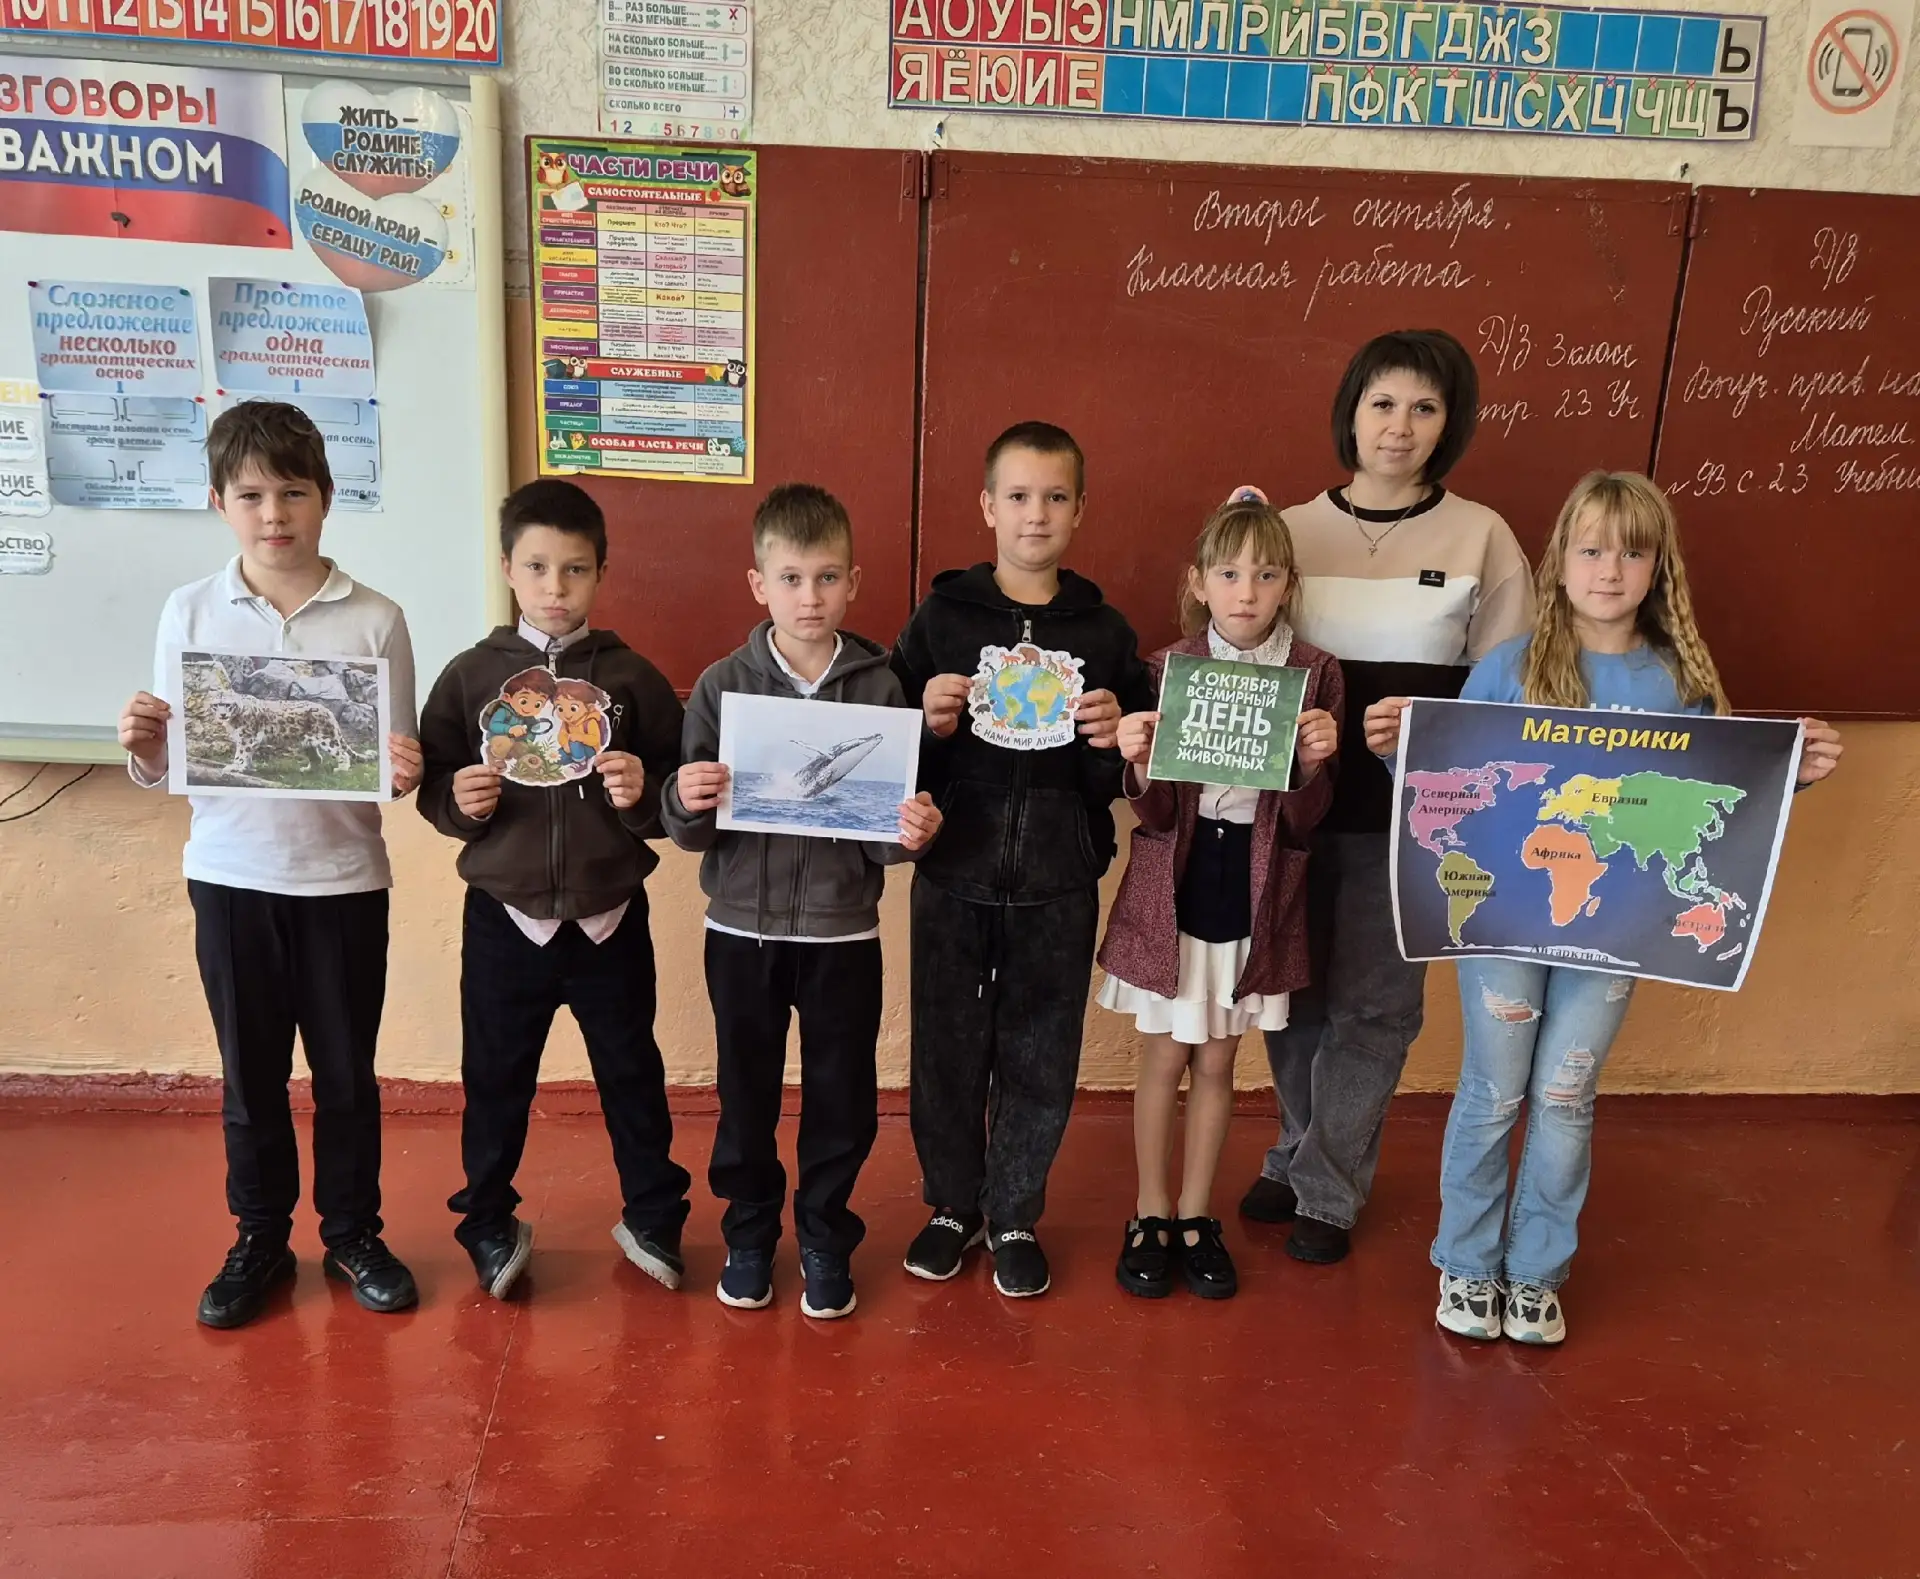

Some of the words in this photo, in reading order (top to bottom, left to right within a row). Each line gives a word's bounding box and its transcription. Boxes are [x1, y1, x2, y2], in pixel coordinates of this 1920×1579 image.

[625, 2, 643, 12] РАЗ
[284, 0, 320, 41] 16
[323, 0, 366, 44] 17
[367, 0, 409, 48] 18
[411, 0, 452, 50] 19
[455, 1, 496, 53] 20
[625, 14, 643, 23] РАЗ
[609, 33, 620, 41] НА
[623, 34, 664, 45] СКОЛЬКО
[609, 45, 621, 53] НА
[623, 46, 664, 57] СКОЛЬКО
[609, 66, 620, 75] ВО
[624, 67, 664, 78] СКОЛЬКО
[609, 78, 620, 86] ВО
[624, 79, 665, 90] СКОЛЬКО
[0, 73, 217, 125] ЗГОВОРЫ
[609, 100, 650, 110] СКОЛЬКО
[653, 103, 681, 113] ВСЕГО
[339, 105, 398, 129] ЖИТЬ
[624, 121, 632, 133] 2
[664, 123, 672, 136] 5
[691, 126, 700, 138] 7
[343, 128, 422, 155] РОДИНЕ
[0, 128, 224, 185] ВАЖНОМ
[333, 153, 433, 180] СЛУЖИТЬ!
[568, 154, 651, 178] ЧАСТИ
[657, 161, 719, 182] РЕЧИ
[587, 187, 702, 201] САМОСТОЯТЕЛЬНЫЕ
[300, 188, 371, 228] РОДНОЙ
[375, 215, 421, 246] КРАЙ
[442, 205, 449, 215] 2
[312, 222, 376, 259] СЕРДЦУ
[379, 247, 420, 275] РАЙ!
[48, 285, 175, 311] Сложное
[233, 282, 347, 311] Простое
[36, 307, 193, 334] предложение
[218, 307, 368, 336] предложение
[1740, 285, 1875, 357] Русский
[59, 335, 177, 355] несколько
[265, 330, 324, 354] одна
[40, 352, 196, 369] грамматических
[219, 350, 370, 369] грамматическая
[96, 367, 145, 380] основ
[268, 365, 325, 379] основа
[610, 366, 683, 379] СЛУЖЕБНЫЕ
[591, 437, 636, 449] ОСОБАЯ
[638, 440, 673, 451] ЧАСТЬ
[677, 441, 704, 451] РЕЧИ
[1189, 669, 1200, 684] 4
[1205, 672, 1280, 694] ОКТЯБРЯ
[1186, 685, 1277, 709] ВСЕМИРНЫЙ
[1181, 698, 1272, 737] ДЕНЬ
[974, 723, 982, 732] С
[984, 729, 1010, 745] НАМИ
[1013, 737, 1033, 747] МИР
[1179, 728, 1269, 757] ЗАЩИТЫ
[1521, 717, 1691, 752] Материки
[1176, 747, 1265, 772] ЖИВОТНЫХ
[1421, 788, 1481, 800] Северная
[1592, 792, 1648, 806] Евразия
[1418, 804, 1475, 816] Америка
[1531, 847, 1581, 860] Африка
[1444, 870, 1491, 881] Южная
[930, 1215, 963, 1233] adidas
[1001, 1229, 1035, 1242] adidas
